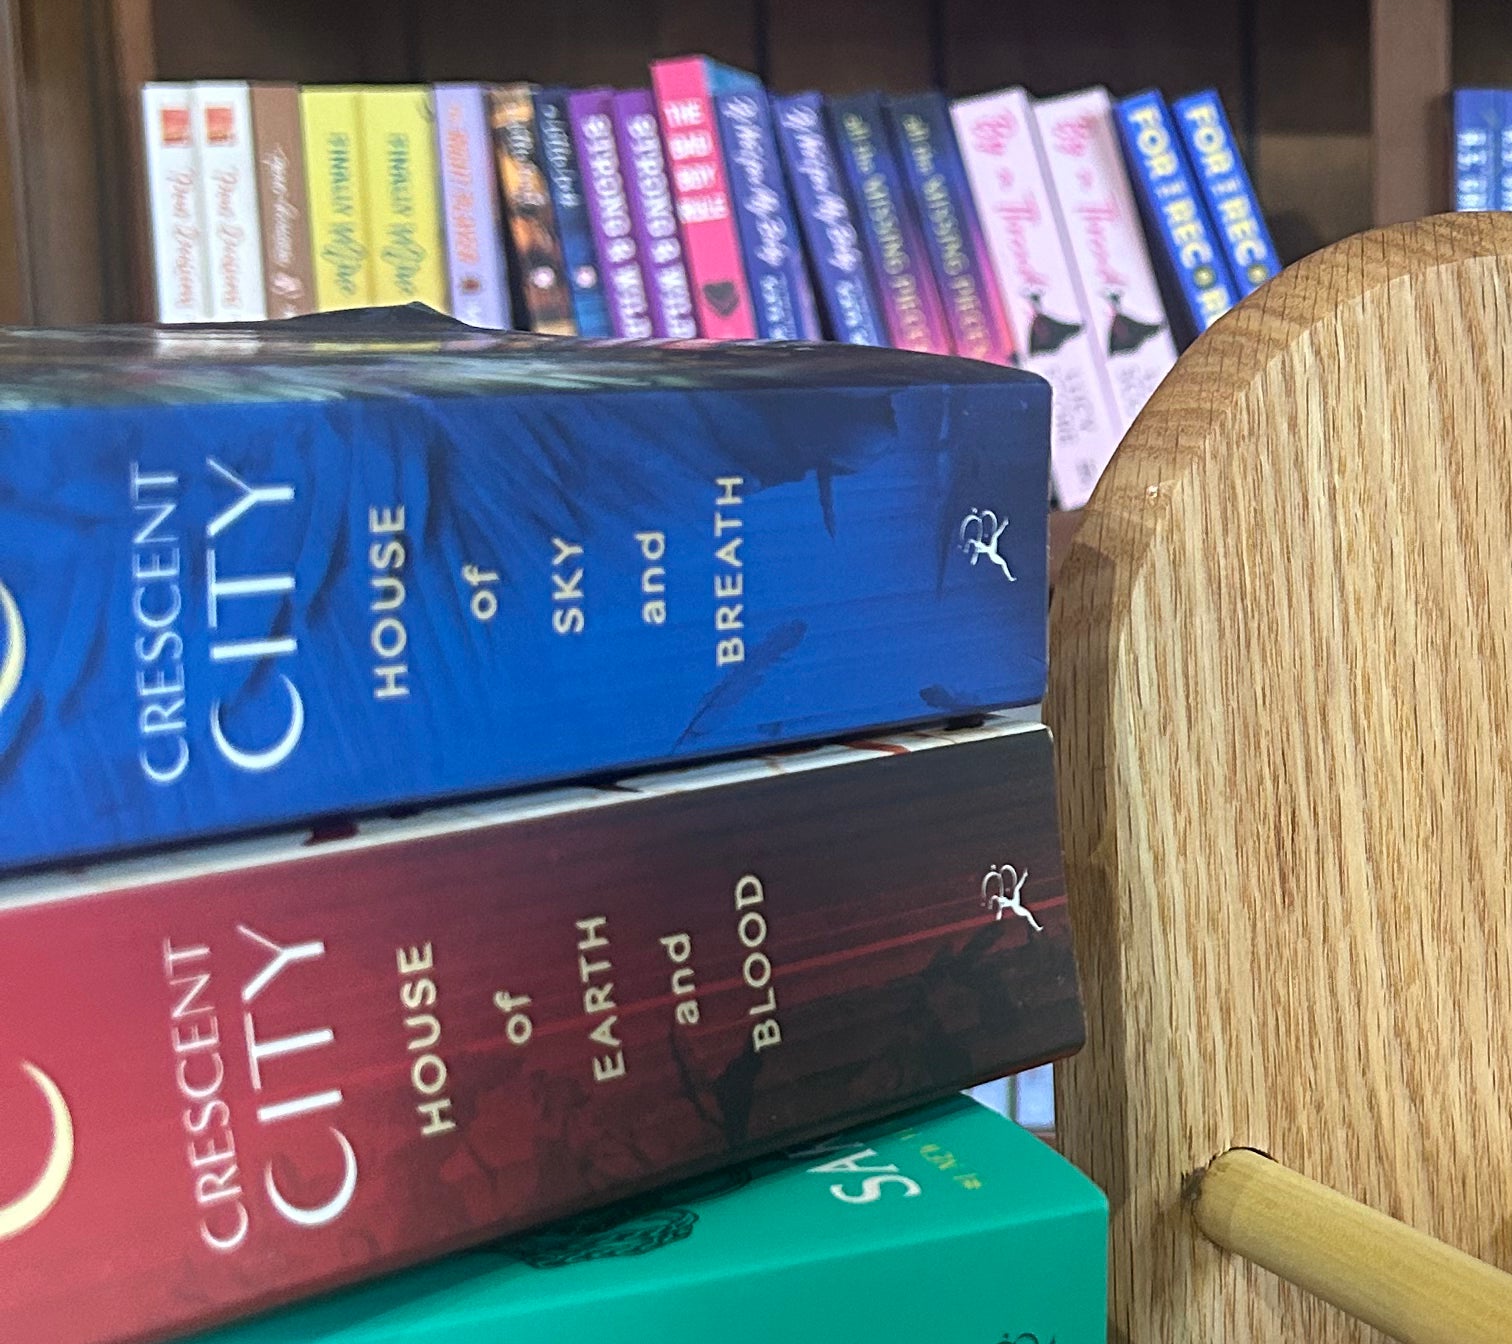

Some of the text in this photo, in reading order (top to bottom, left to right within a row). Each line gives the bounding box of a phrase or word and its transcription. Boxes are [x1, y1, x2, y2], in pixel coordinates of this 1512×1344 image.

[582, 113, 630, 237] STRONG
[627, 113, 677, 238] STRONG
[1127, 108, 1175, 179] FOR
[1184, 102, 1234, 179] FOR
[128, 459, 192, 784] CRESCENT
[205, 456, 305, 774] CITY
[368, 503, 413, 700] HOUSE
[462, 564, 504, 621] of
[551, 535, 587, 636] SKY
[633, 529, 668, 626] and
[712, 474, 748, 666] BREATH
[493, 989, 535, 1046] of
[574, 913, 629, 1083] EARTH
[660, 932, 701, 1027] and
[733, 872, 783, 1050] BLOOD
[162, 935, 251, 1250] CRESCENT
[235, 921, 361, 1228] CITY
[395, 939, 455, 1136] HOUSE
